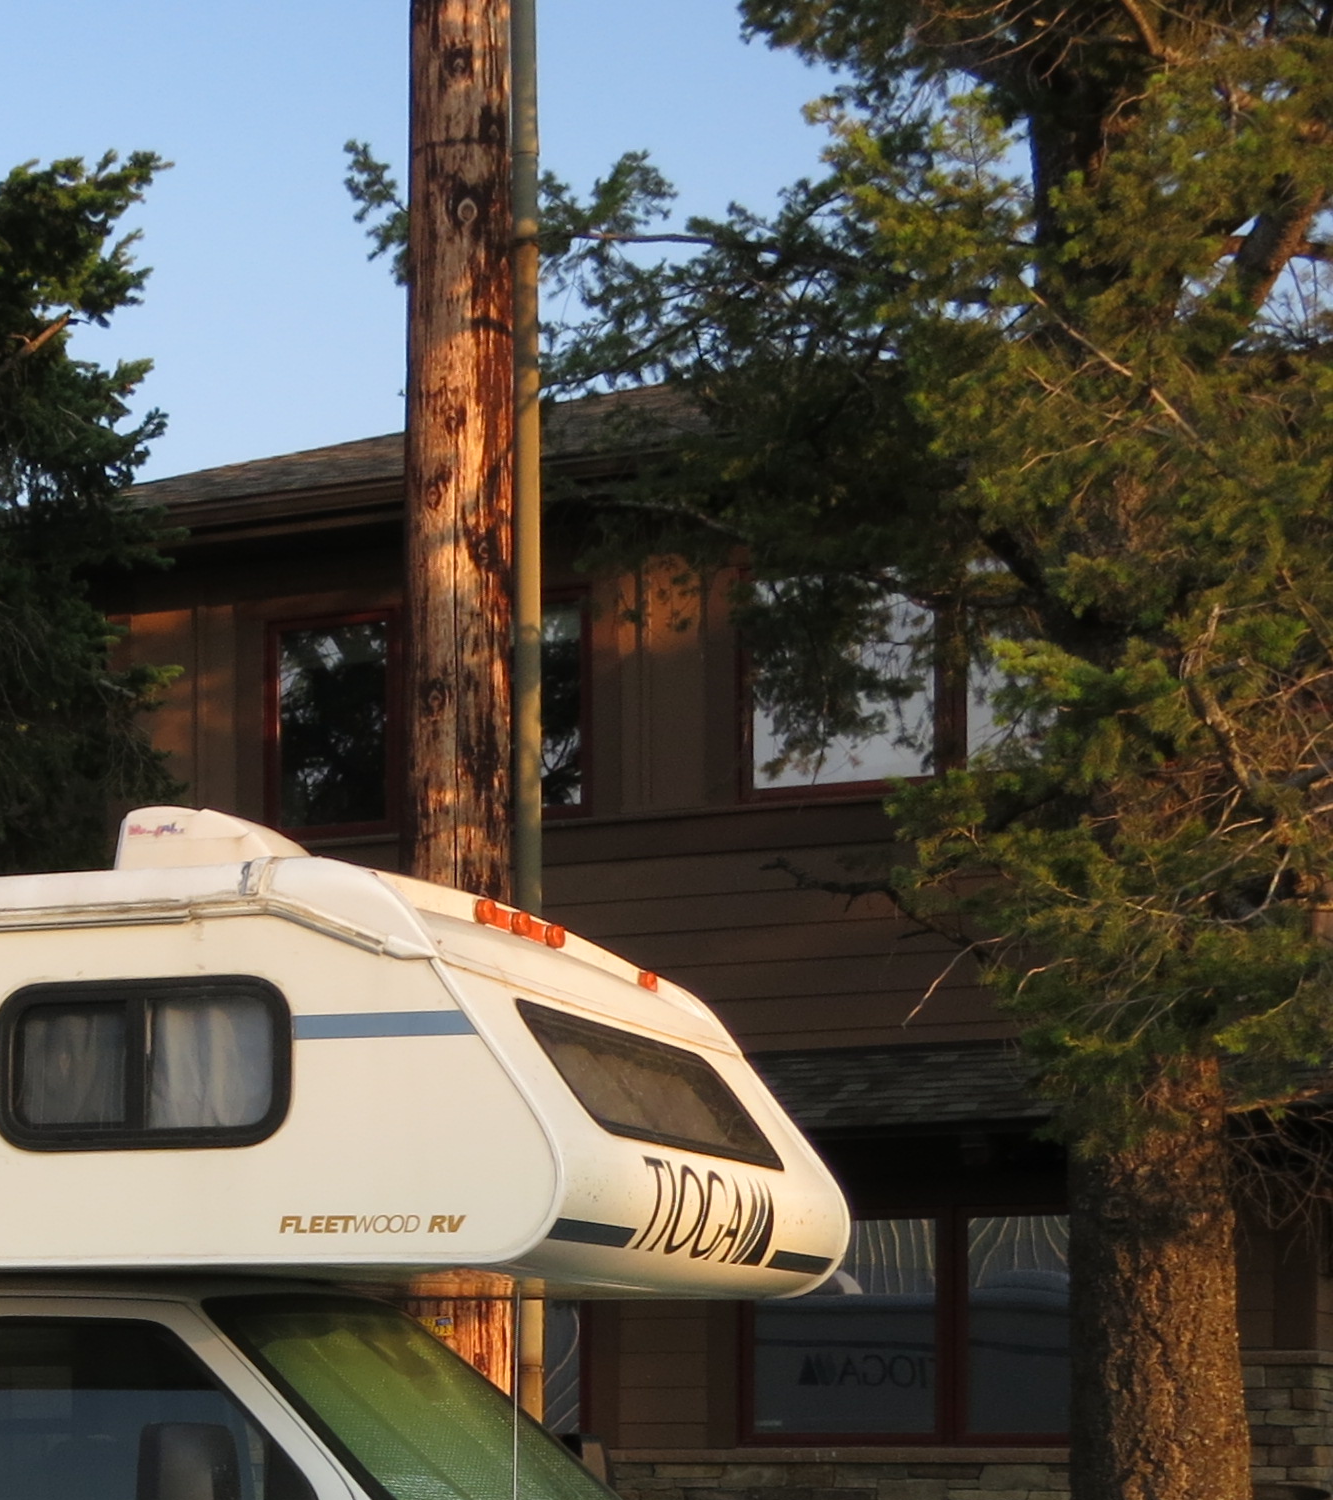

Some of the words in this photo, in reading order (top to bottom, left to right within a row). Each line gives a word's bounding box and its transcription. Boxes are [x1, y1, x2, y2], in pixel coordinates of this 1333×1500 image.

[279, 1214, 421, 1234] FLEETWOOD
[426, 1214, 467, 1234] RV
[632, 1154, 743, 1263] TIOGA
